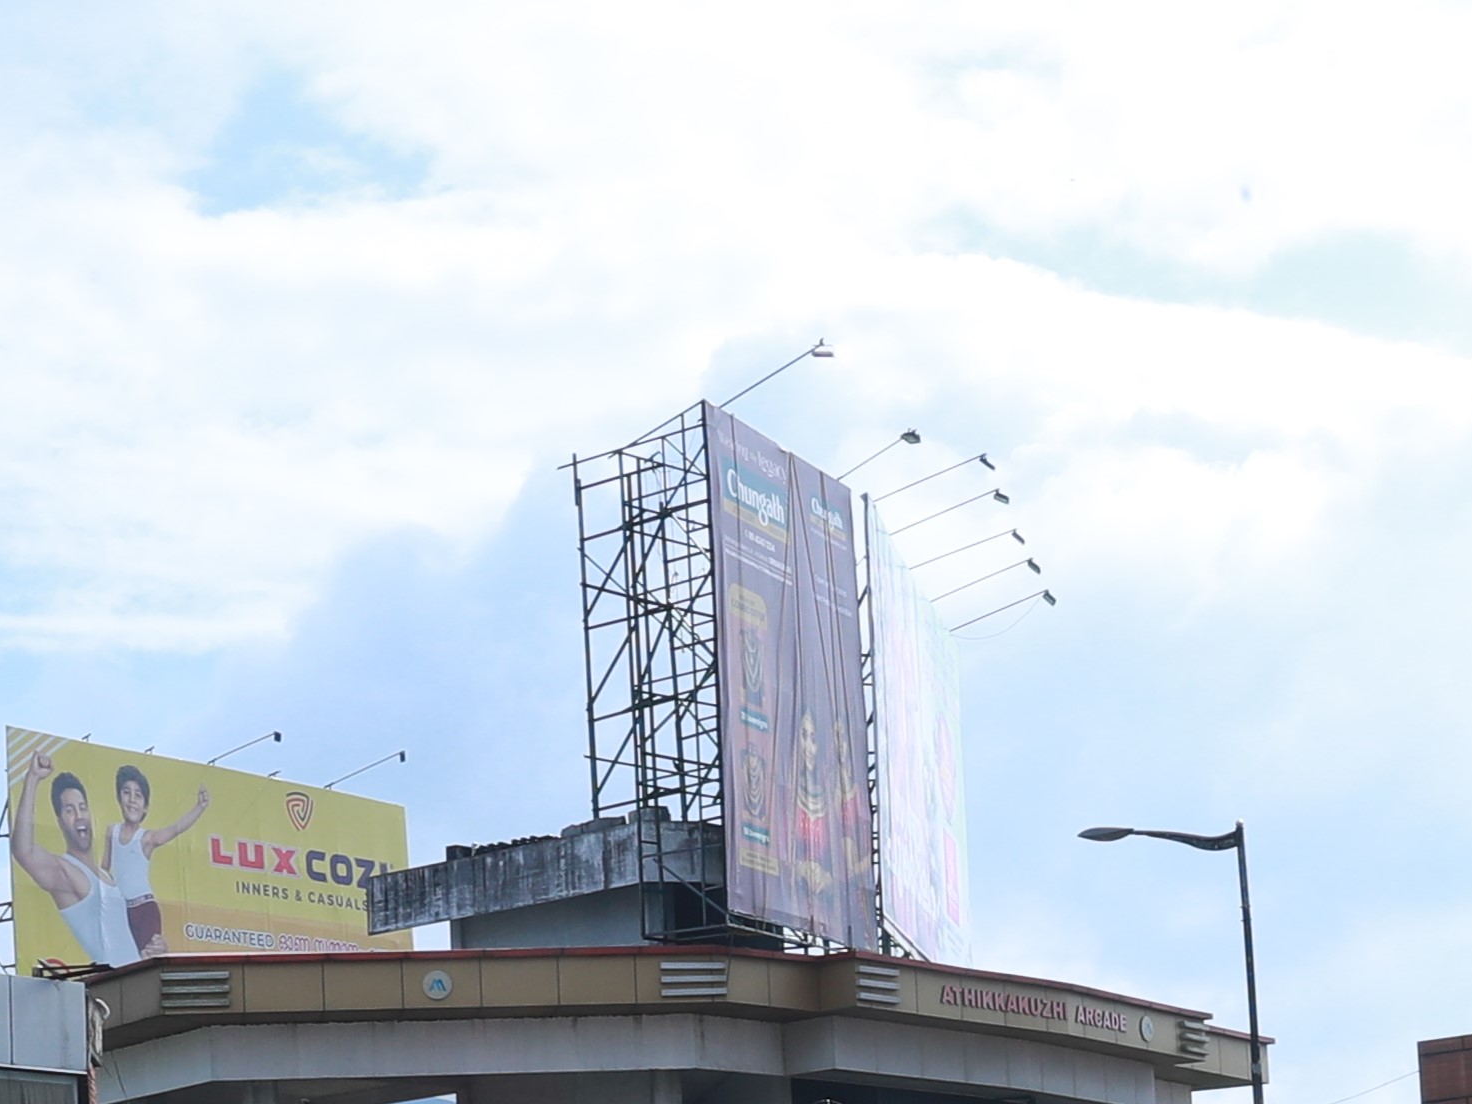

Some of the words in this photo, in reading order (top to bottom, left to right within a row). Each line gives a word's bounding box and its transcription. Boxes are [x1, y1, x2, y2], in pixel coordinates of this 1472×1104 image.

[727, 468, 785, 526] Chungath
[209, 834, 300, 878] LUX
[236, 880, 289, 901] INNERS
[295, 890, 303, 902] &
[307, 892, 369, 913] CASUALS
[184, 922, 275, 950] GUARANTEED
[941, 985, 1066, 1020] ATHIKKAKUZHI
[1075, 1005, 1128, 1033] ARCADE
